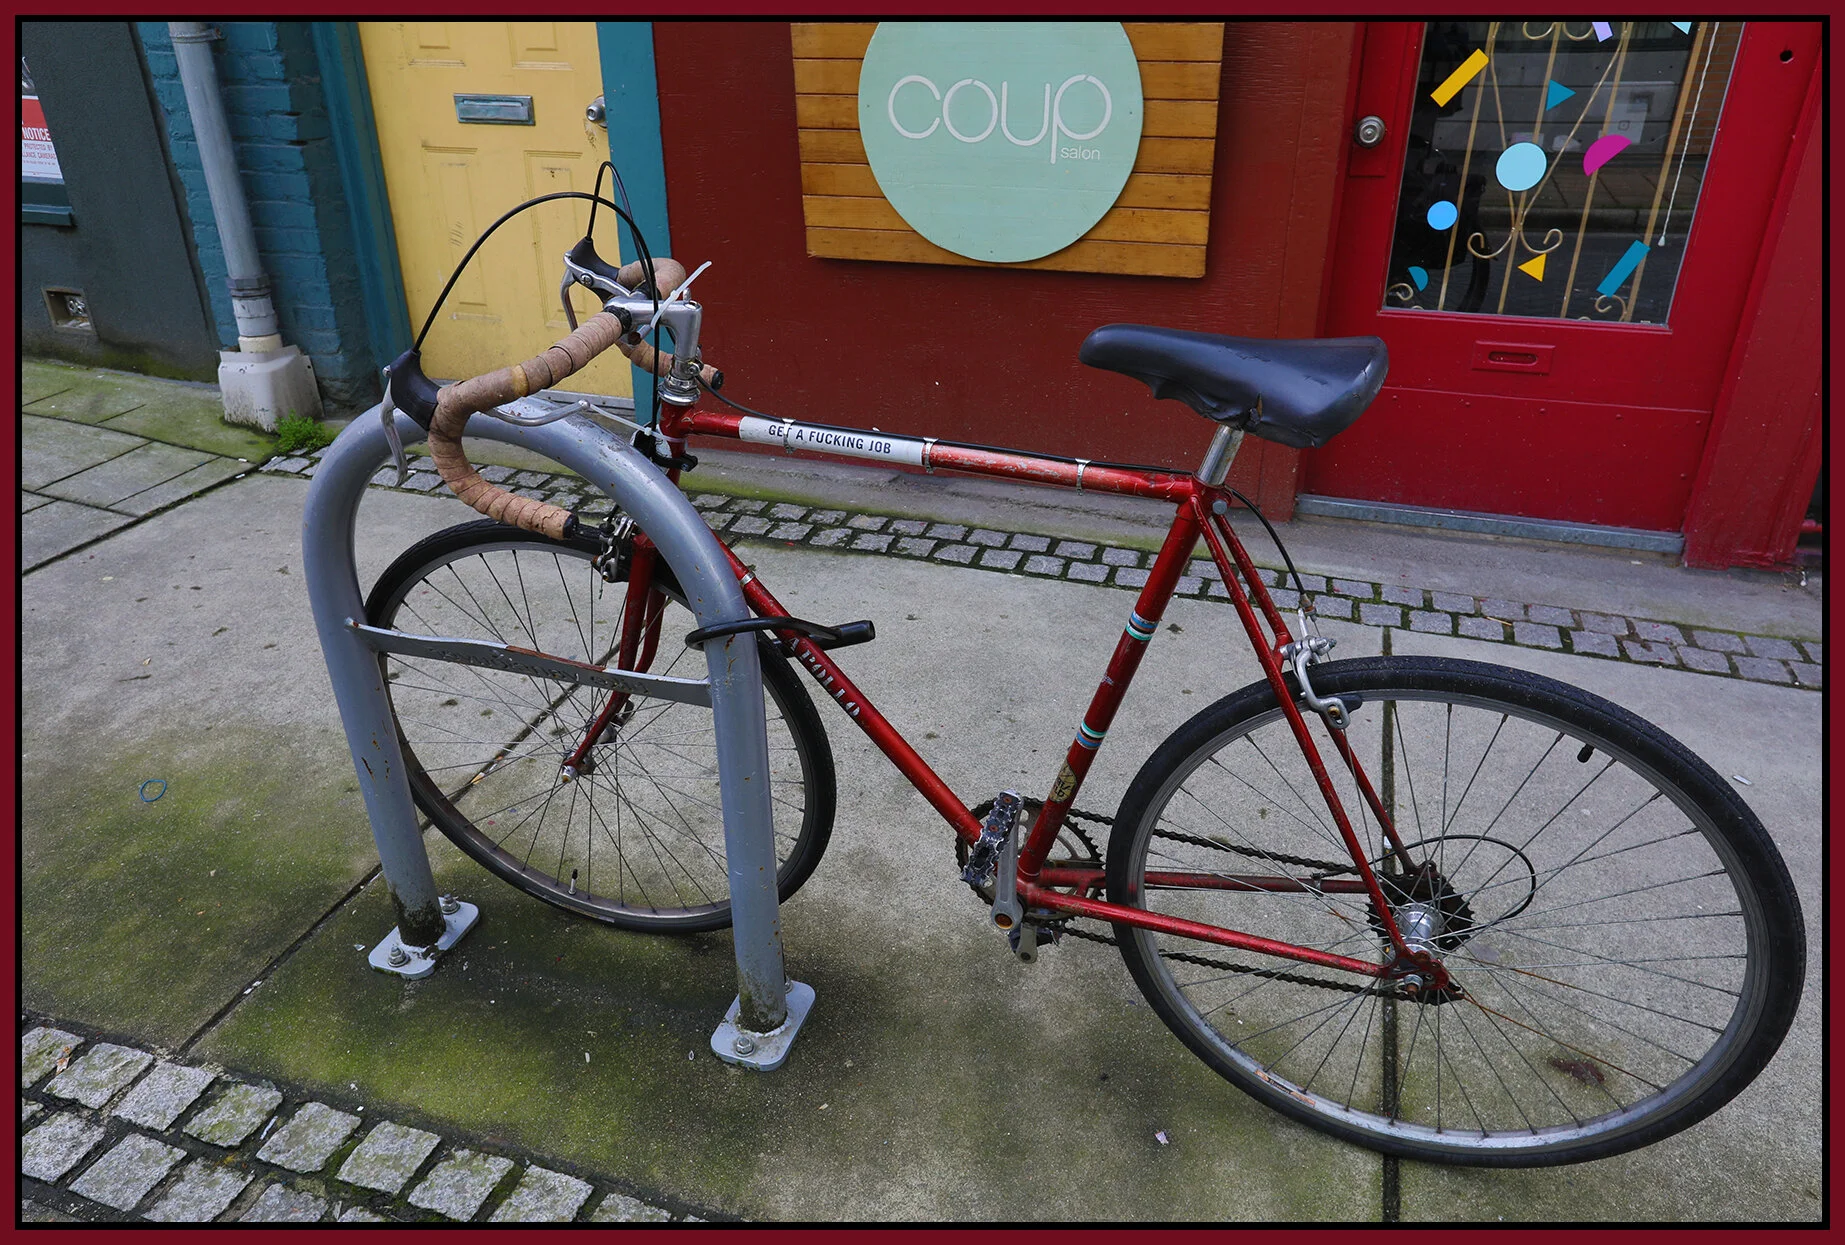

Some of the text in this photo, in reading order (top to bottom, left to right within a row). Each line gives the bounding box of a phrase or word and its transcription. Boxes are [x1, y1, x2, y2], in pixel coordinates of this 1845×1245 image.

[888, 74, 1112, 164] coup
[22, 127, 51, 140] NOTICE
[1060, 145, 1101, 160] salon
[795, 429, 804, 441] A
[808, 431, 864, 450] FUCKING
[868, 440, 891, 454] JOB
[789, 637, 860, 717] APOLLO
